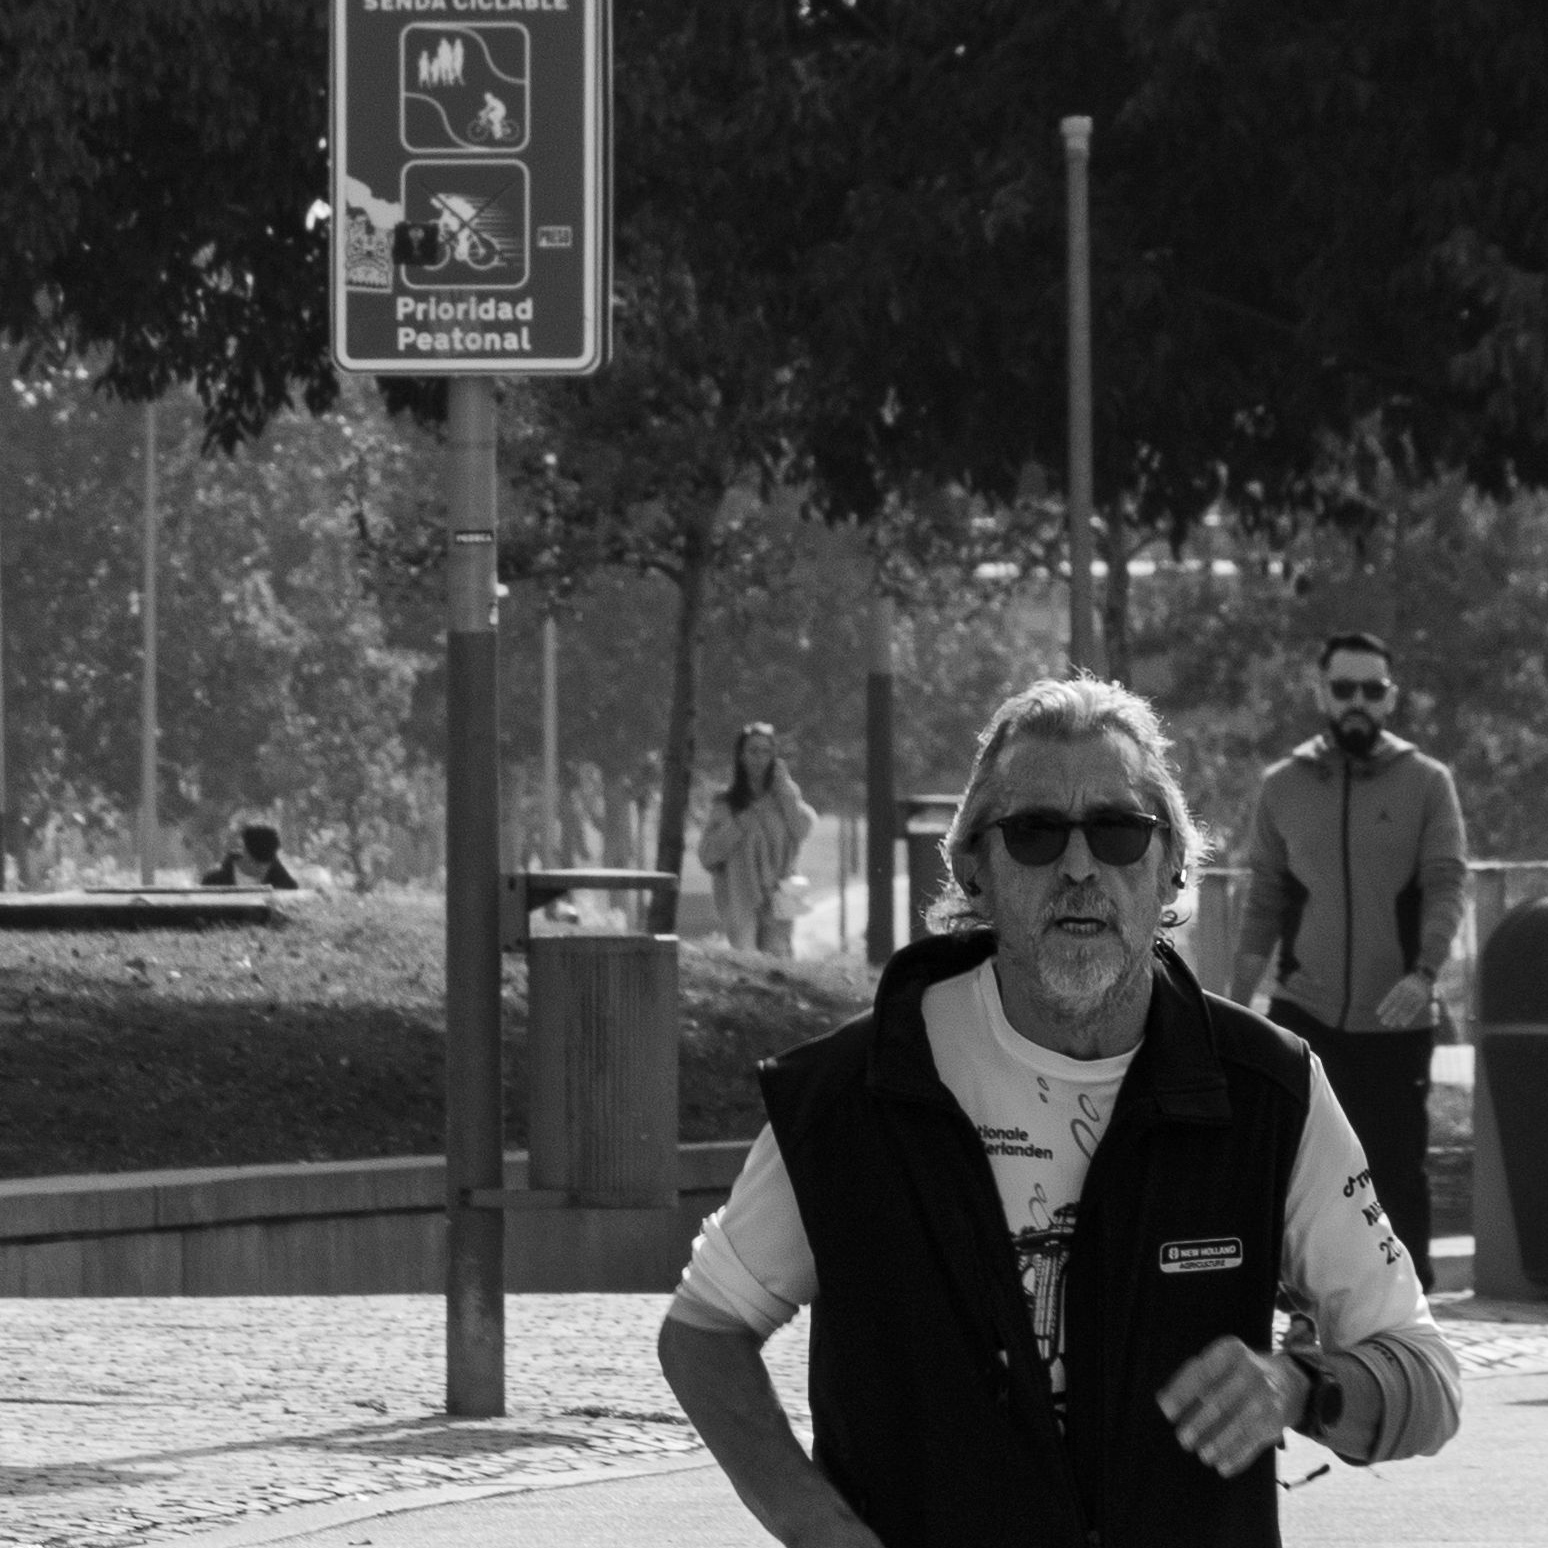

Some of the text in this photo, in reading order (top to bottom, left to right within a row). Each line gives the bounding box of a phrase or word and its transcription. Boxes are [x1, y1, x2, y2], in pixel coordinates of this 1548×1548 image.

[396, 296, 533, 321] Prioridad
[397, 326, 532, 351] Peatonal
[1180, 1245, 1236, 1257] NEW HOLLAND
